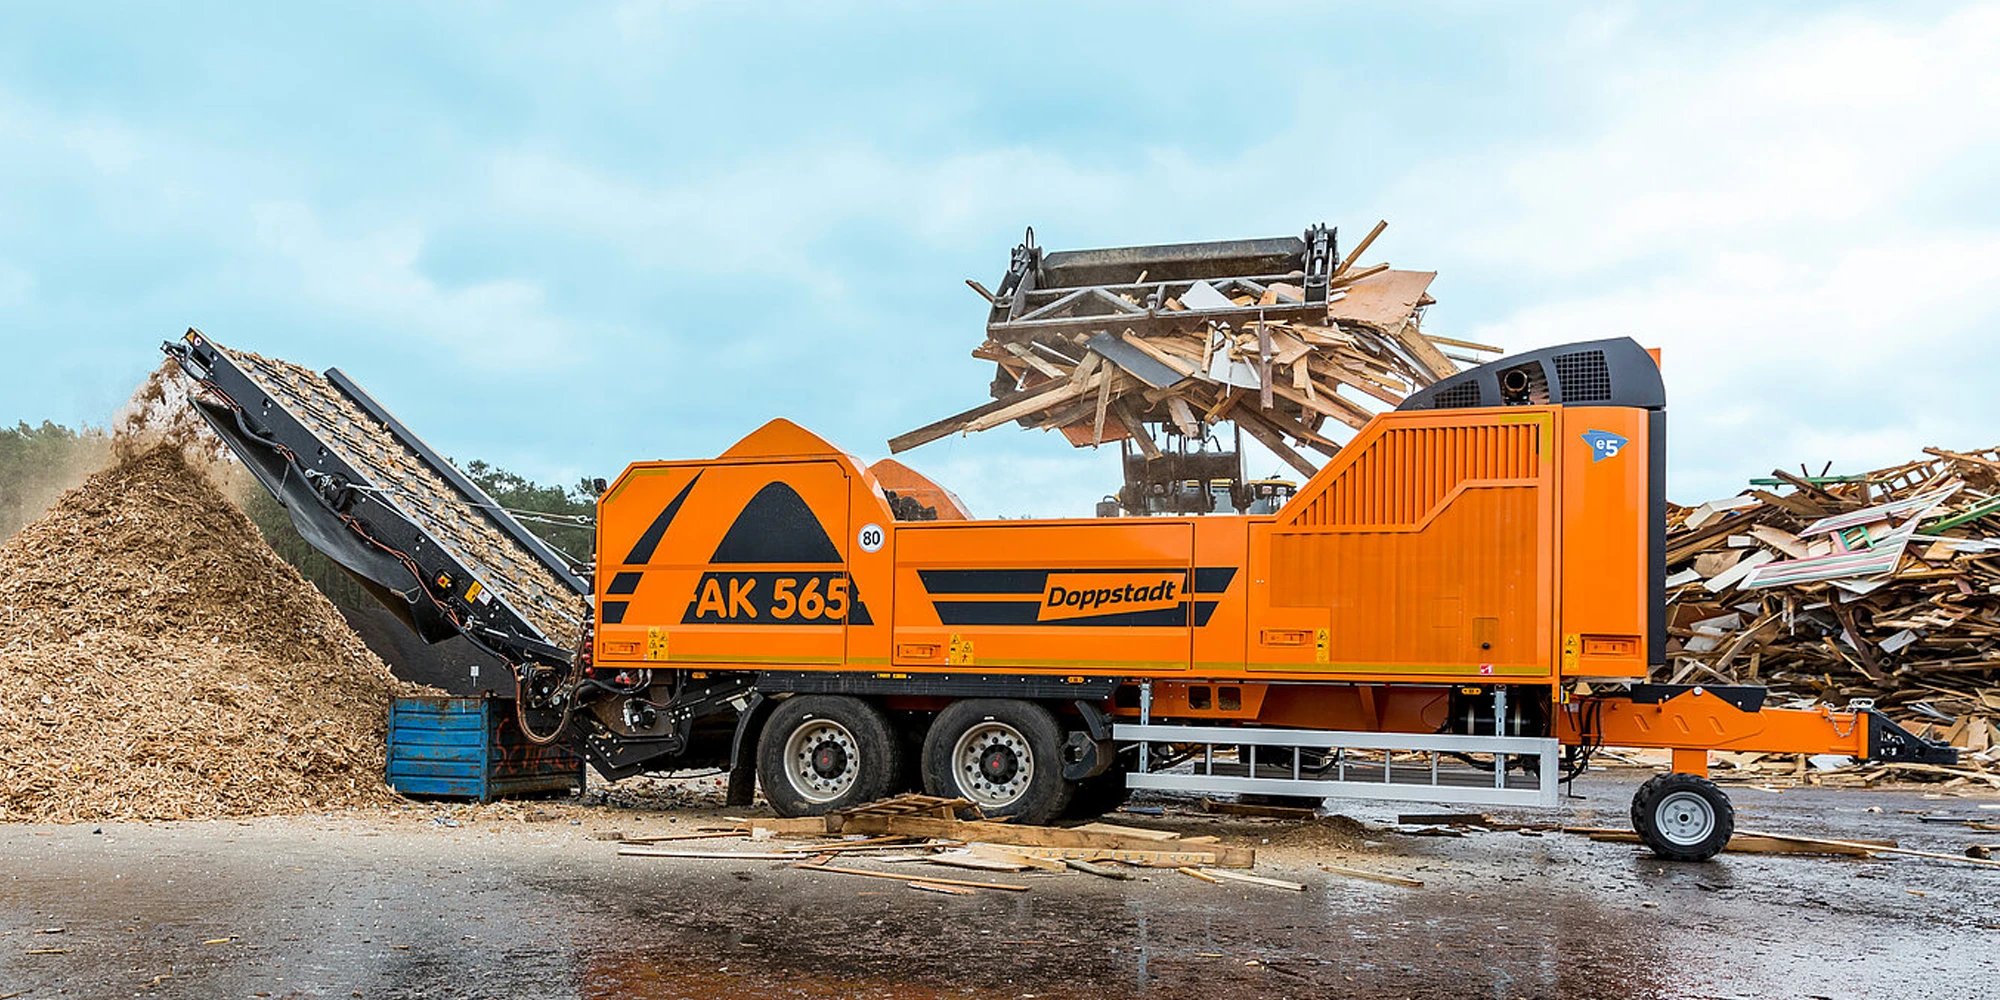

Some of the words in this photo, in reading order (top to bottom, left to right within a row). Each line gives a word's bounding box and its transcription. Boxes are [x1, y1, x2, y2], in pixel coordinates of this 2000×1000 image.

[863, 530, 880, 546] 80
[696, 577, 758, 619] AK
[770, 577, 850, 620] 565
[1047, 580, 1176, 610] Doppstadt
